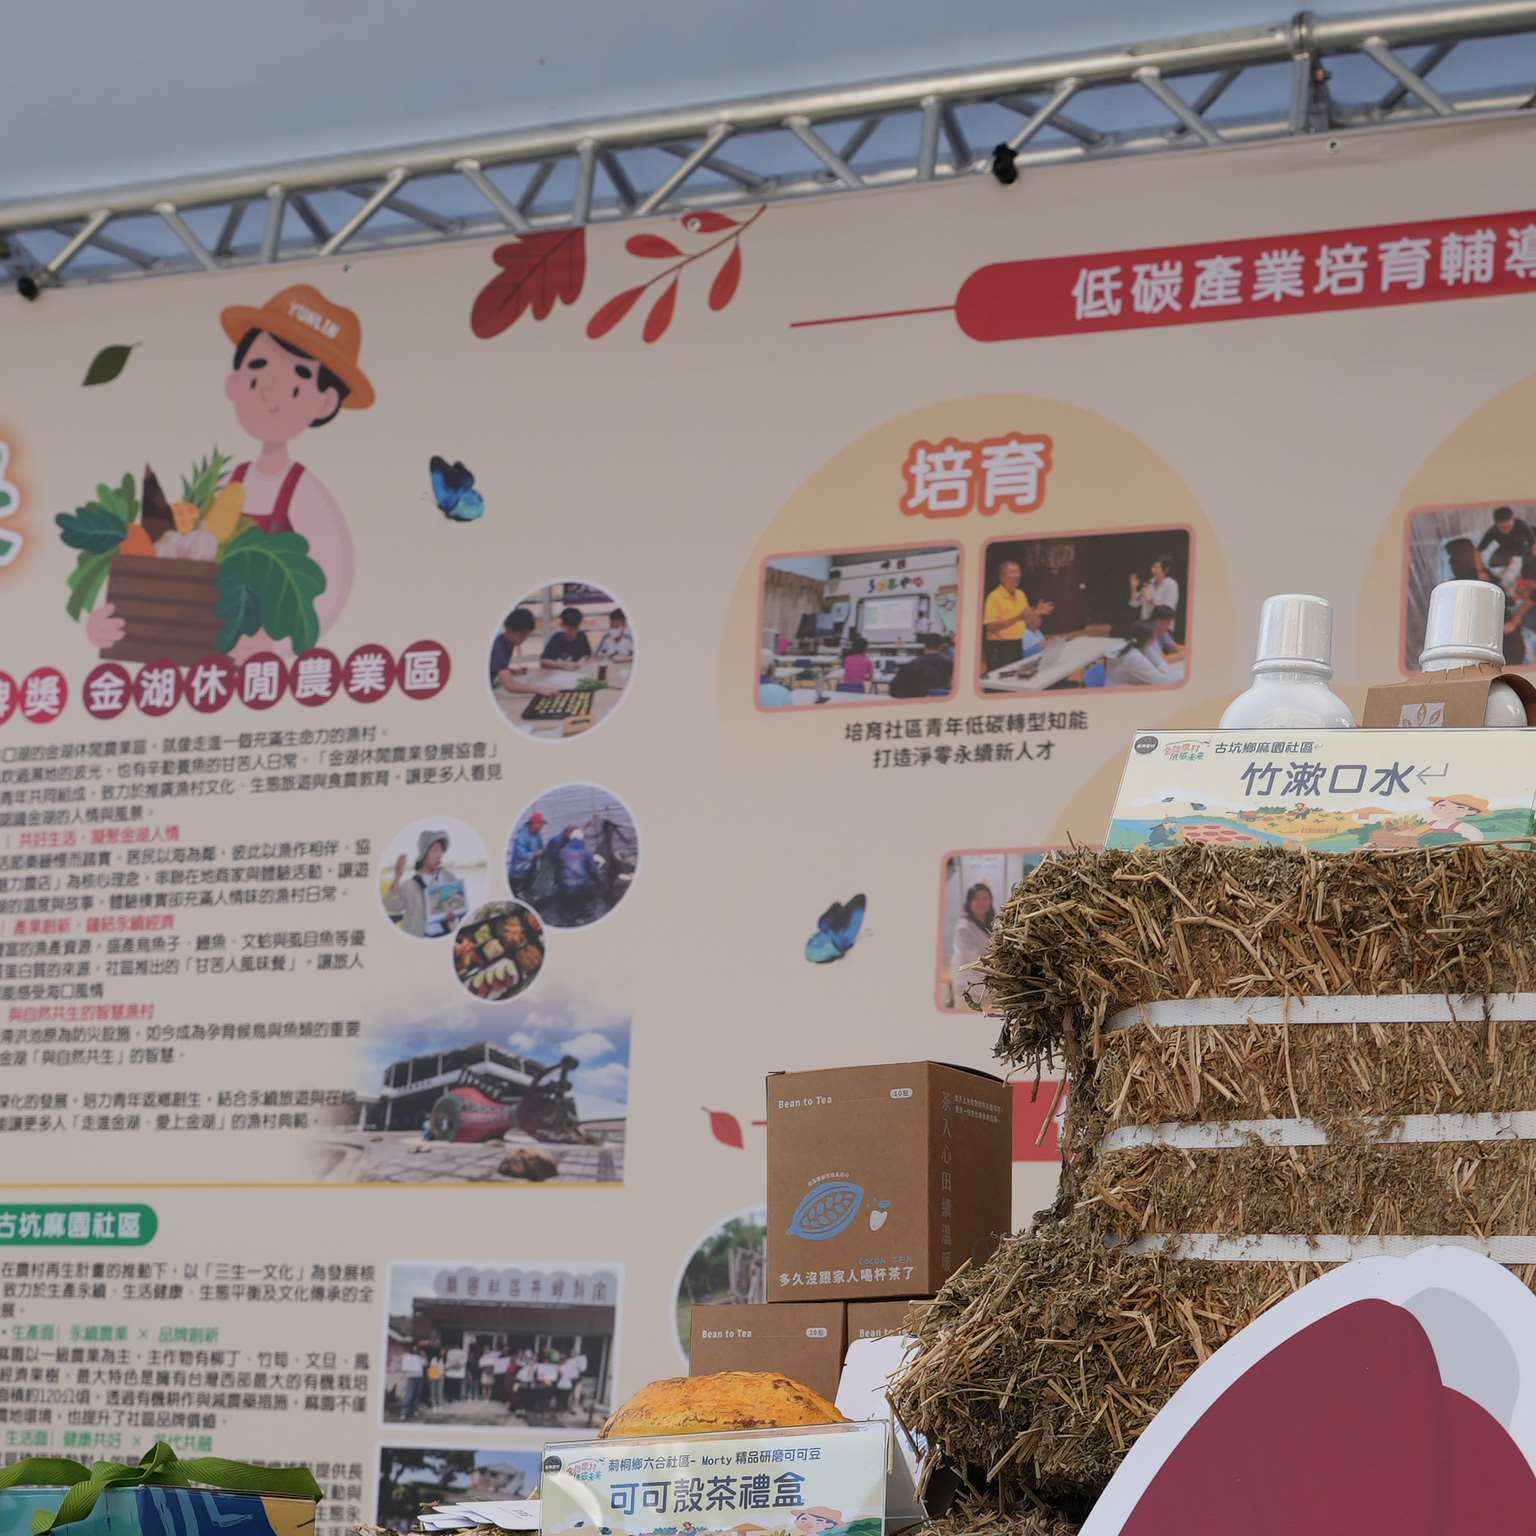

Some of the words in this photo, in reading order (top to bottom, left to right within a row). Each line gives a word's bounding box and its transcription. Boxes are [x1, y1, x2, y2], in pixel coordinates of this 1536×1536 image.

[910, 439, 1049, 511] 培育
[89, 649, 447, 713] 金湖休閒農業區
[845, 711, 1088, 741] 培育社區青年低碳轉型知能
[873, 741, 1055, 768] 打造淨零永續新人才
[1215, 741, 1314, 753] 古坑鄉麻園社區
[1241, 762, 1414, 797] 竹漱口水
[779, 1098, 800, 1108] Bean
[803, 1097, 813, 1106] to
[816, 1096, 832, 1105] Tea
[778, 1266, 914, 1287] 多久沒跟家人喝杯茶了
[702, 1329, 723, 1338] Bean
[726, 1329, 734, 1338] to
[737, 1329, 752, 1338] Tea
[859, 1328, 882, 1338] Bean
[702, 1455, 732, 1467] Morty
[735, 1447, 823, 1464] 精品研磨可可豆
[610, 1471, 805, 1515] 可可殼茶禮盒
